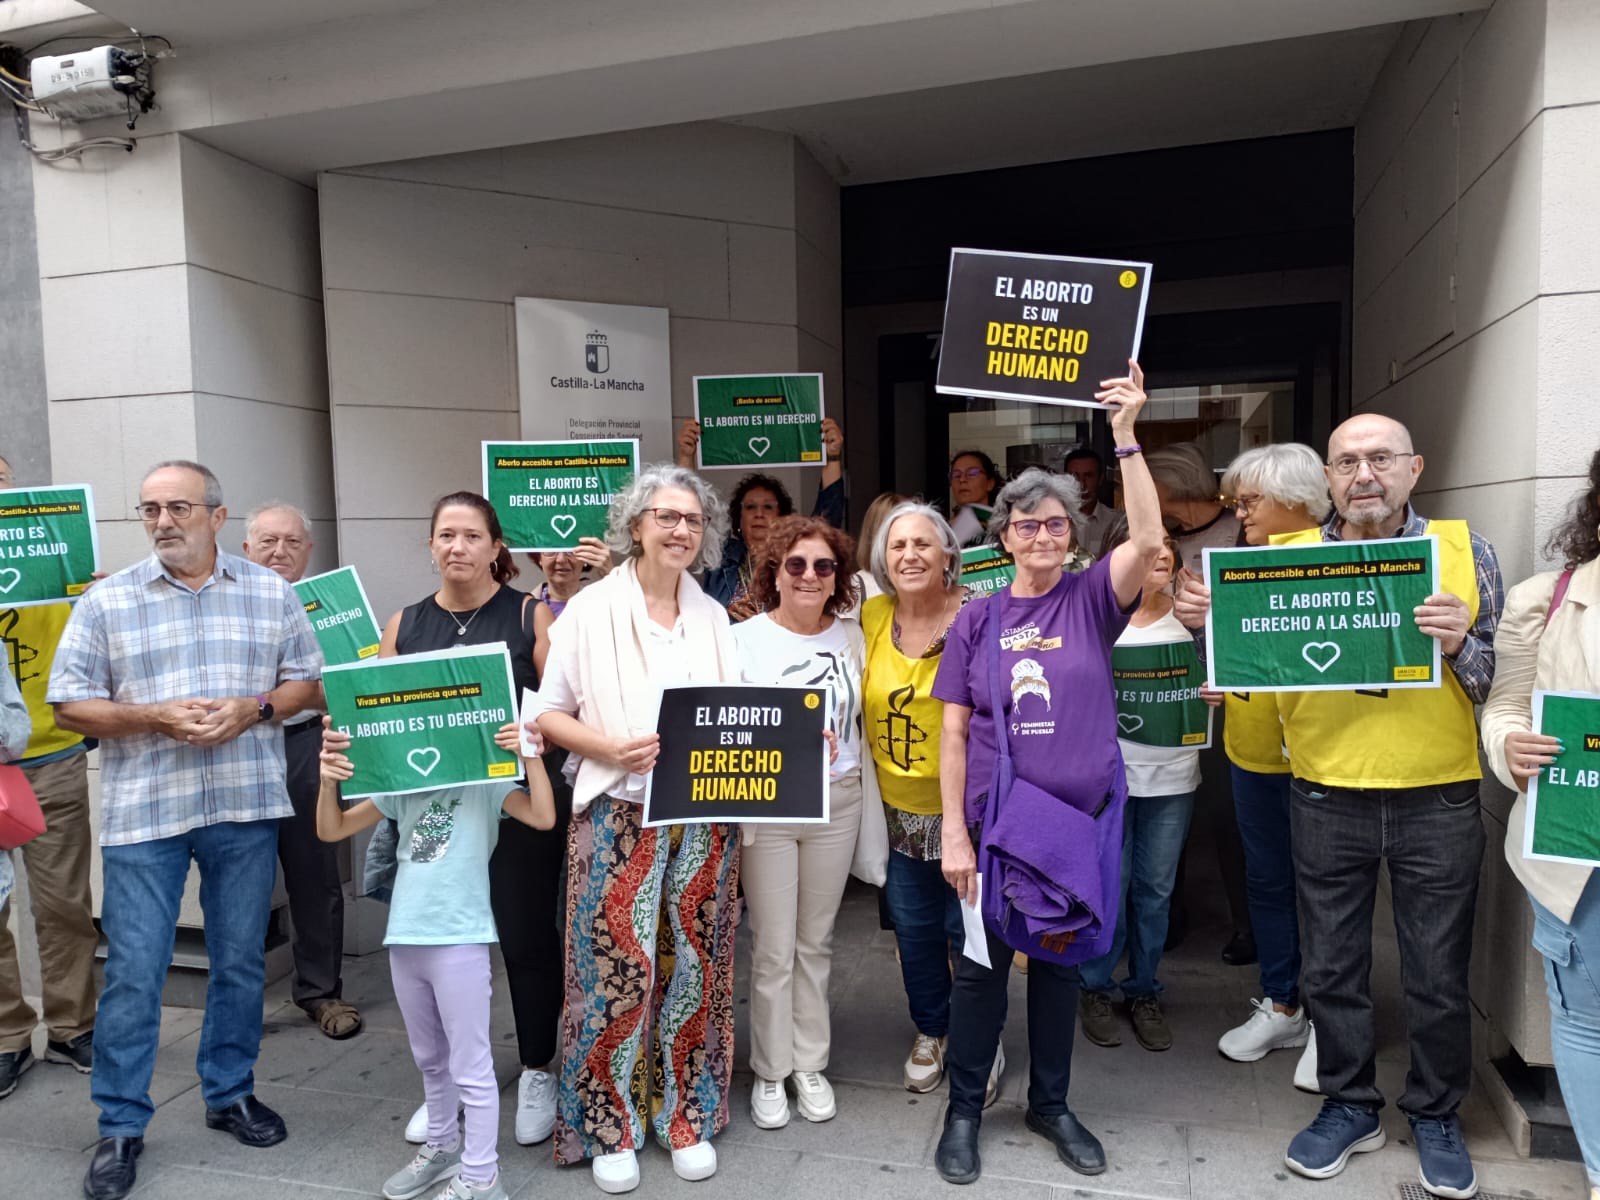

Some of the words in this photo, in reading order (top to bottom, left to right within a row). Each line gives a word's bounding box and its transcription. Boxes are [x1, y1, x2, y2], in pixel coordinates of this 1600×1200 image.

[995, 276, 1016, 298] EL
[1020, 279, 1093, 305] ABORTO
[1022, 305, 1038, 320] ES
[1041, 307, 1059, 323] UN
[986, 321, 1089, 355] DERECHO
[987, 350, 1080, 383] HUMANO
[607, 379, 645, 391] Mancha
[569, 418, 607, 429] Delegación
[608, 419, 641, 429] Provincial
[703, 417, 714, 428] EL
[716, 415, 750, 427] ABORTO
[751, 415, 762, 426] ES
[764, 414, 775, 425] MI
[777, 413, 817, 425] DERECHO
[497, 458, 521, 467] Aborto
[521, 457, 553, 466] accesible
[564, 457, 598, 466] Castilla-La
[599, 456, 627, 465] Mancha
[529, 478, 541, 490] EL
[544, 477, 583, 489] ABORTO
[585, 476, 598, 489] ES
[509, 495, 557, 507] DERECHO
[560, 495, 567, 506] A
[569, 494, 581, 506] LA
[583, 493, 615, 506] SALUD
[40, 505, 67, 514] Mancha
[68, 504, 81, 512] YA!
[28, 526, 45, 540] ES
[8, 545, 25, 559] LA
[27, 542, 69, 557] SALUD
[1223, 570, 1256, 582] Aborto
[1258, 567, 1304, 579] accesible
[1307, 568, 1320, 577] en
[1322, 563, 1377, 577] Castilla-La
[1380, 561, 1421, 573] Mancha
[995, 576, 1008, 588] ES
[1269, 594, 1288, 610] EL
[1291, 591, 1351, 610] ABORTO
[1356, 590, 1375, 607] ES
[316, 607, 363, 631] DERECHO
[1241, 615, 1311, 633] DERECHO
[1315, 615, 1326, 631] A
[1330, 614, 1348, 630] LA
[1352, 612, 1401, 630] SALUD
[1004, 631, 1036, 647] HASTA
[1122, 669, 1156, 679] provincia
[1157, 670, 1170, 679] que
[1171, 667, 1188, 676] vivas
[356, 696, 378, 707] Vivas
[379, 696, 391, 704] en
[393, 694, 401, 703] la
[403, 689, 440, 704] provincia
[442, 688, 457, 700] que
[459, 685, 480, 696] vivas
[1122, 690, 1136, 702] ES
[1140, 691, 1154, 703] TU
[338, 725, 353, 739] EL
[357, 718, 405, 738] ABORTO
[409, 716, 425, 732] ES
[428, 714, 444, 730] TU
[447, 707, 506, 728] DERECHO
[695, 706, 713, 726] EL
[717, 706, 782, 726] ABORTO
[1020, 720, 1055, 729] FEMINISTAS
[1030, 728, 1055, 736] PUEBLO
[720, 731, 734, 745] ES
[737, 731, 753, 745] UN
[689, 750, 783, 774] DERECHO
[1548, 767, 1570, 785] EL
[691, 777, 777, 801] HUMANO
